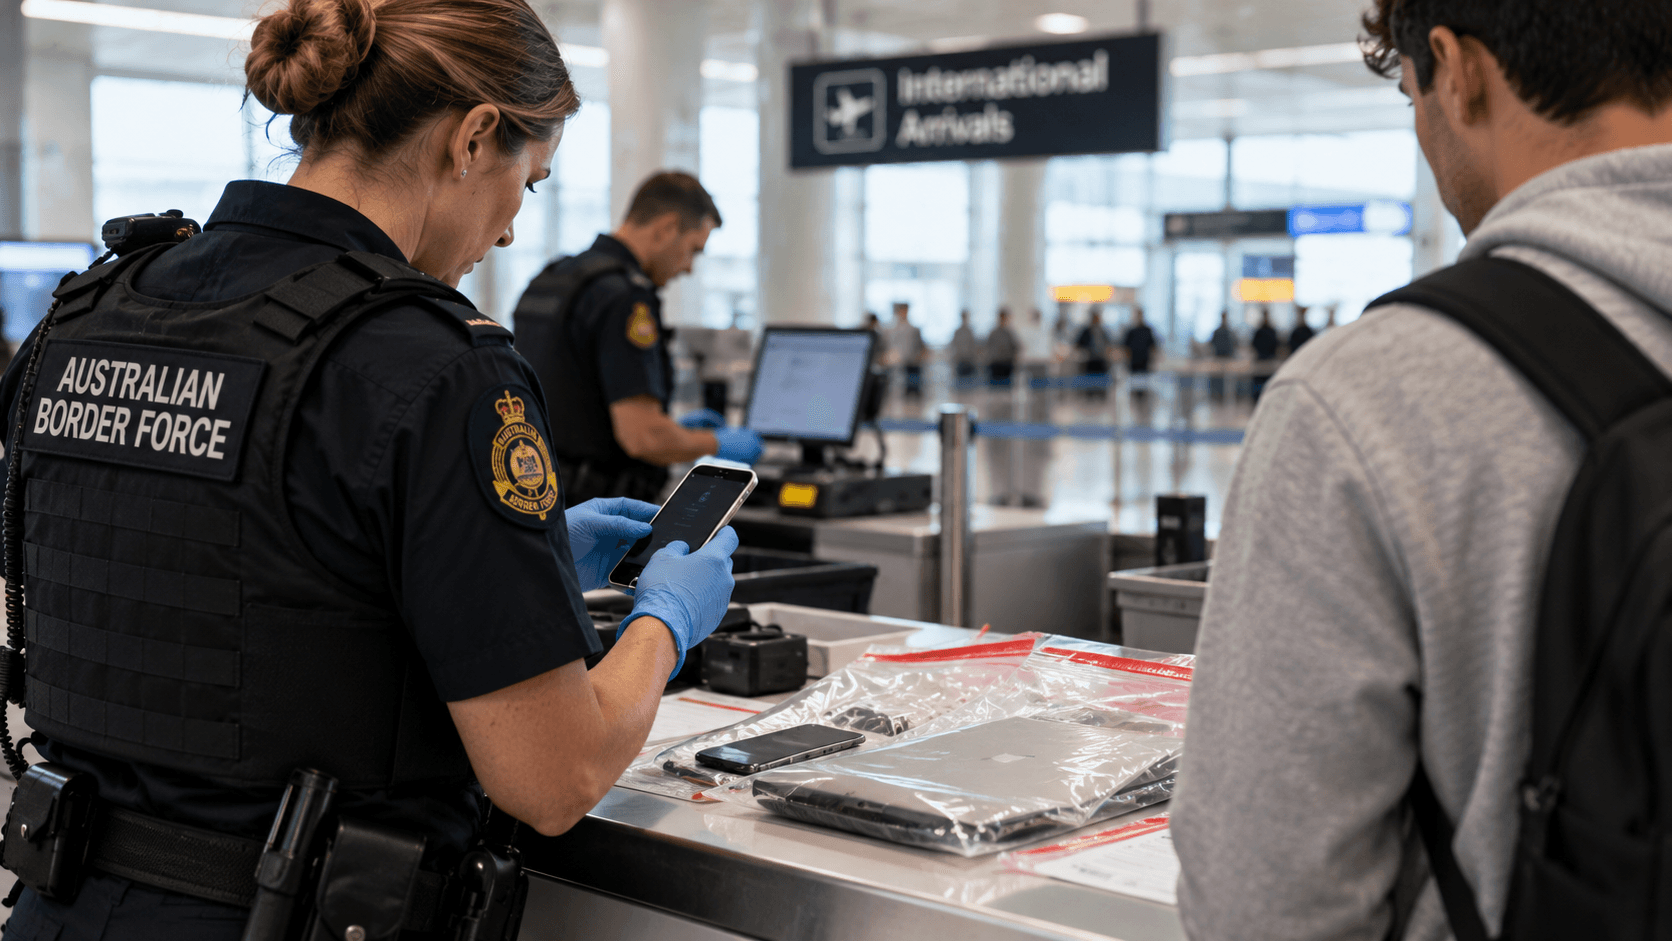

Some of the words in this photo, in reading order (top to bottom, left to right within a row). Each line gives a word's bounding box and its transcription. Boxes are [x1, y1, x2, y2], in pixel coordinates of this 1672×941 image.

[898, 50, 1108, 105] International
[896, 103, 1014, 148] Arrivals
[56, 356, 225, 410] AUSTRALIAN
[33, 397, 132, 446] BORDER
[134, 409, 232, 460] FORCE
